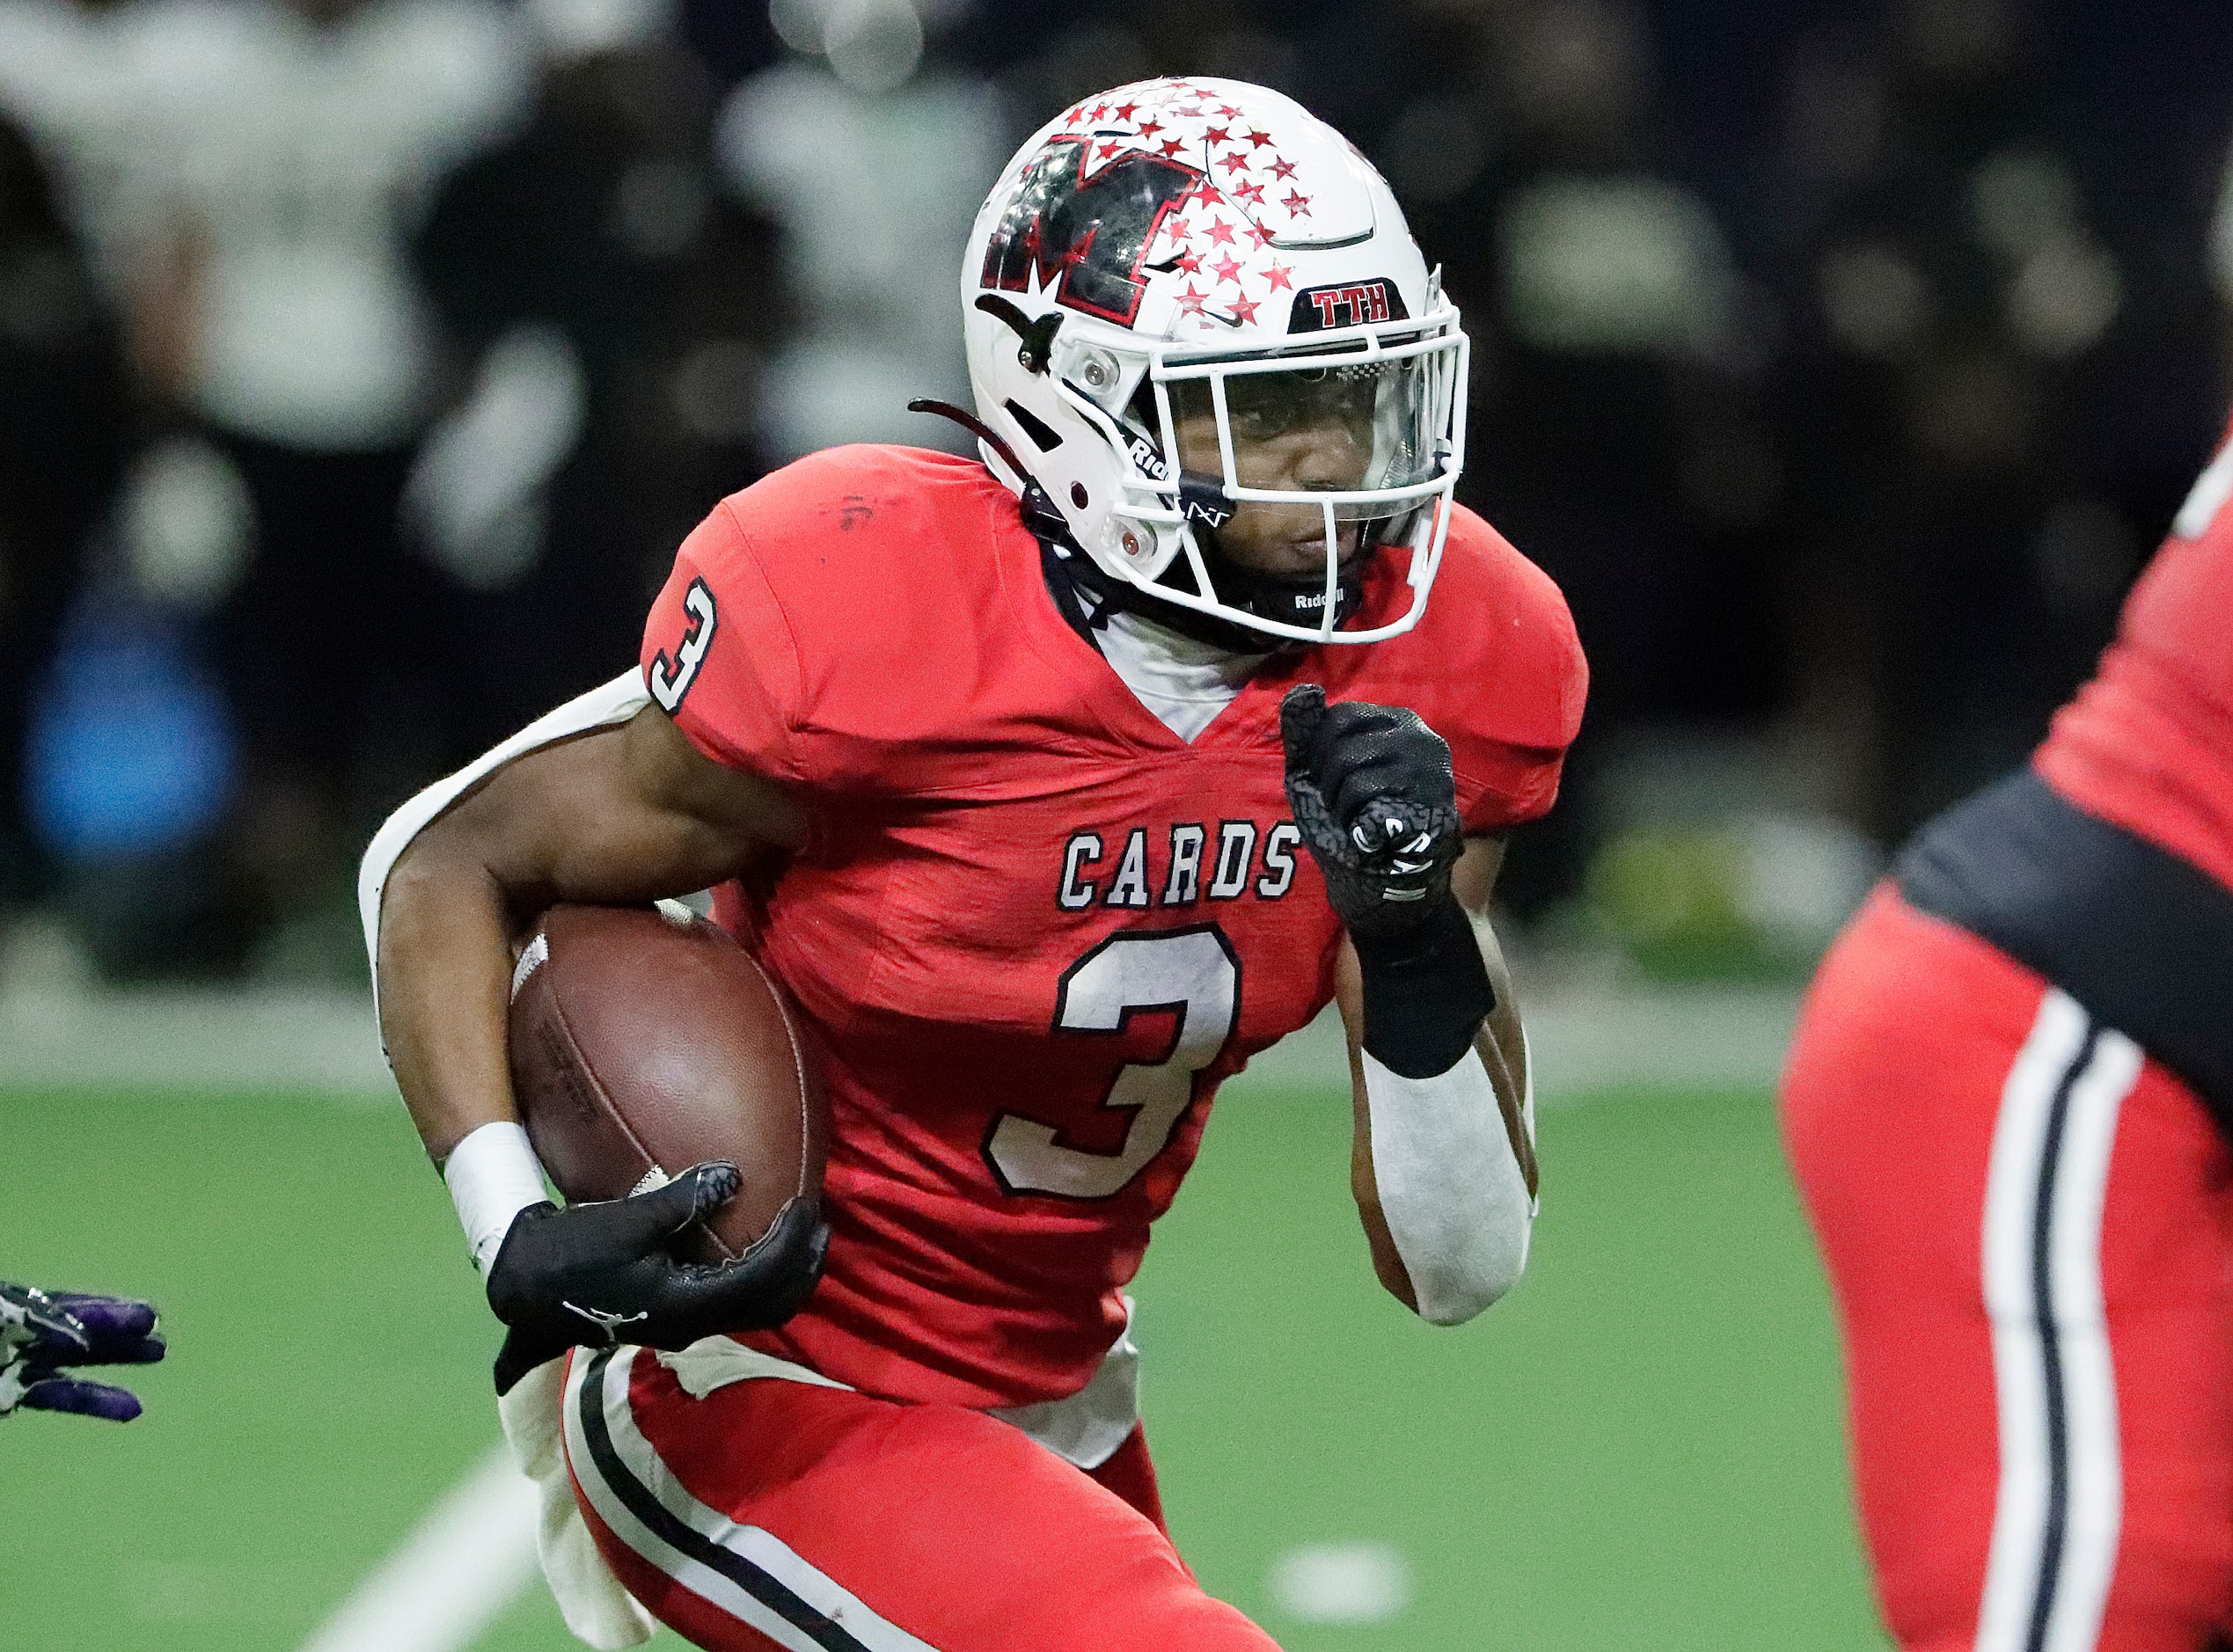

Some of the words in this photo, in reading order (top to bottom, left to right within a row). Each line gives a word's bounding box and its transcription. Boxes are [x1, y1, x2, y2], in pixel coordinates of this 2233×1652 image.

[1308, 282, 1390, 328] TTH
[649, 575, 718, 715] 3
[1057, 818, 1302, 910] CARDS
[979, 922, 1241, 1199] 3
